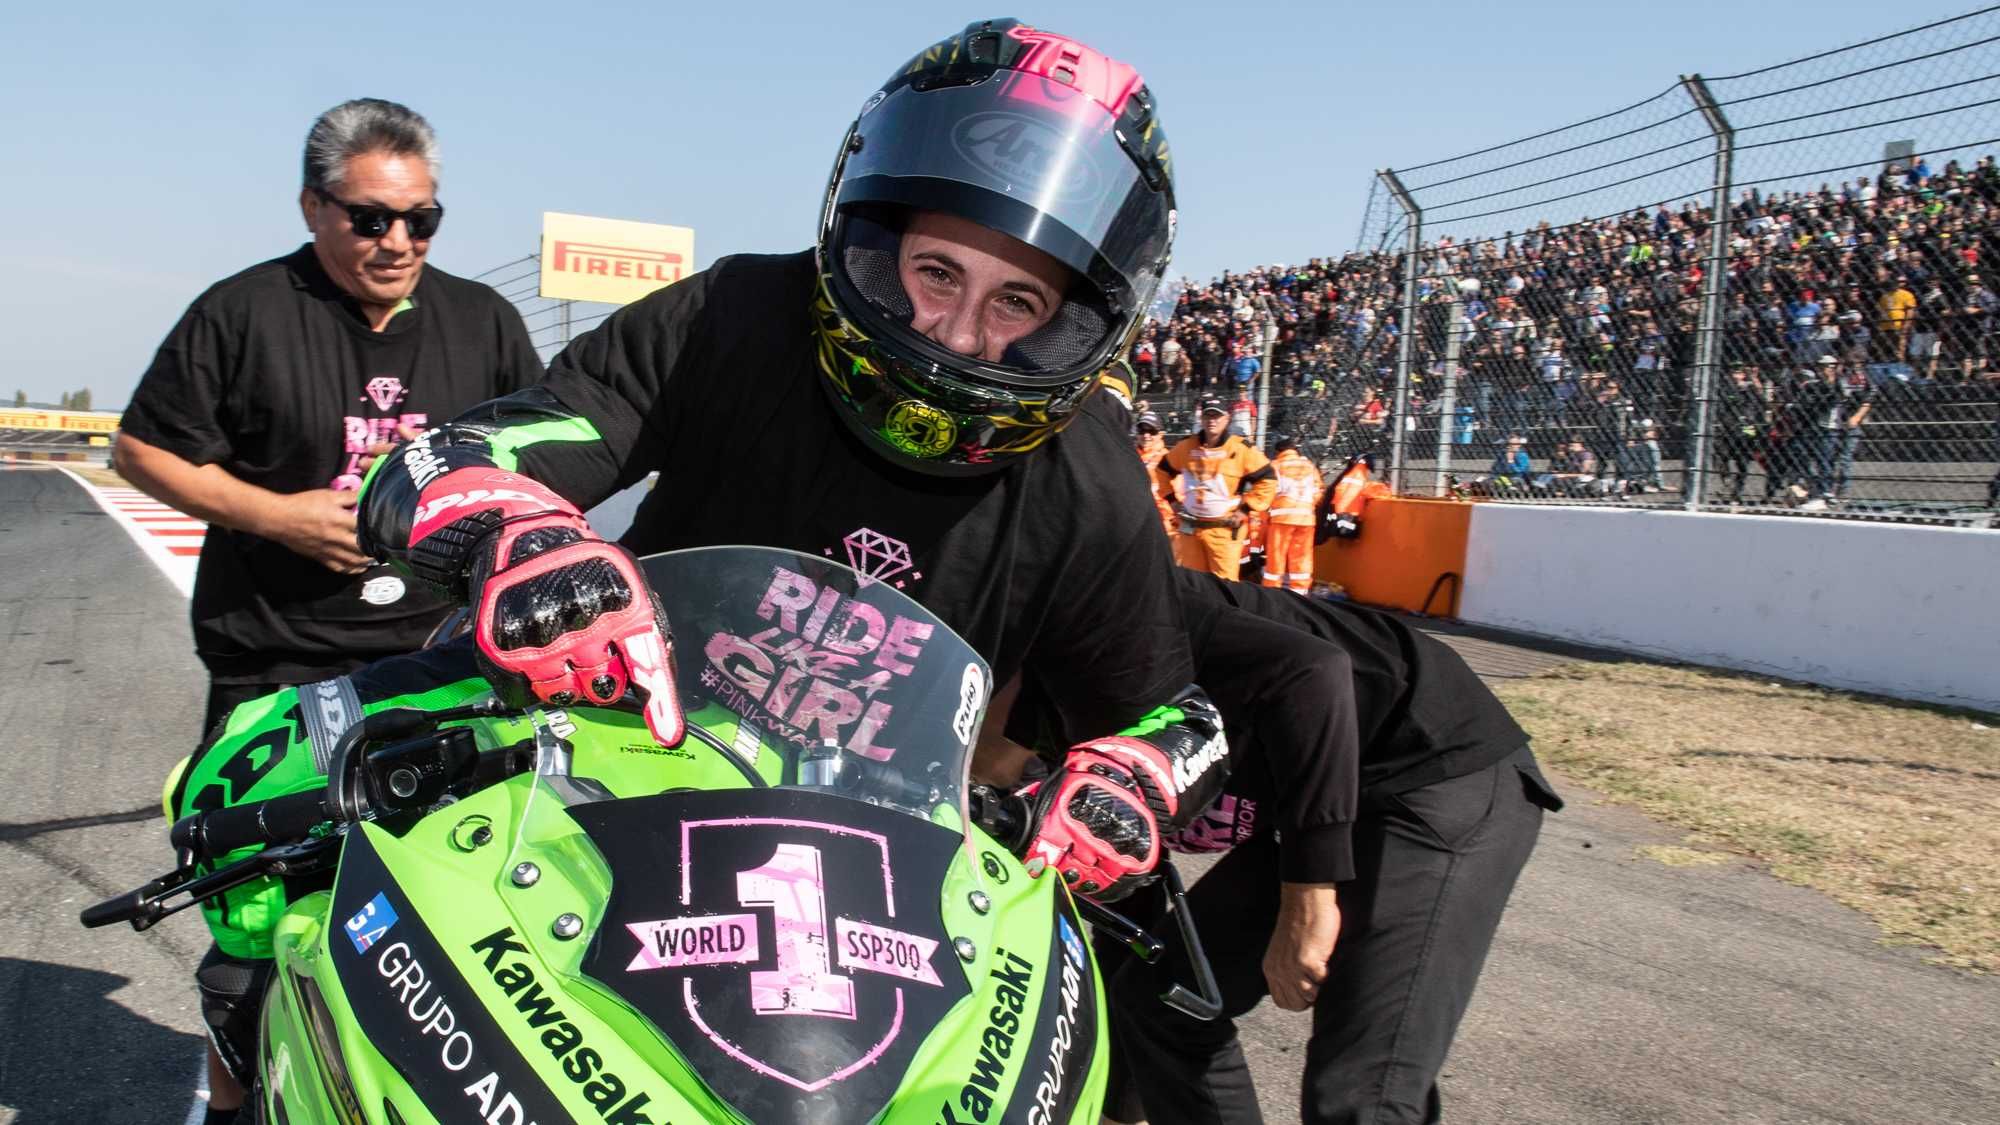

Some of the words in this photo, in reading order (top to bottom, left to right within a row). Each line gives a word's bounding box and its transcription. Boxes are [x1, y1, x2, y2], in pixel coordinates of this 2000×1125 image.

[553, 240, 683, 283] PIRELLI
[749, 626, 861, 682] LIKE
[847, 670, 893, 701] A
[756, 565, 935, 677] RIDE
[703, 631, 897, 762] GIRL
[654, 924, 746, 959] WORLD
[736, 843, 857, 1021] 1
[846, 930, 921, 971] SSP300
[377, 942, 473, 1071] GRUPO
[464, 1071, 537, 1125] AD
[470, 926, 673, 1125] Kawasak
[1027, 1014, 1072, 1125] GRUPO
